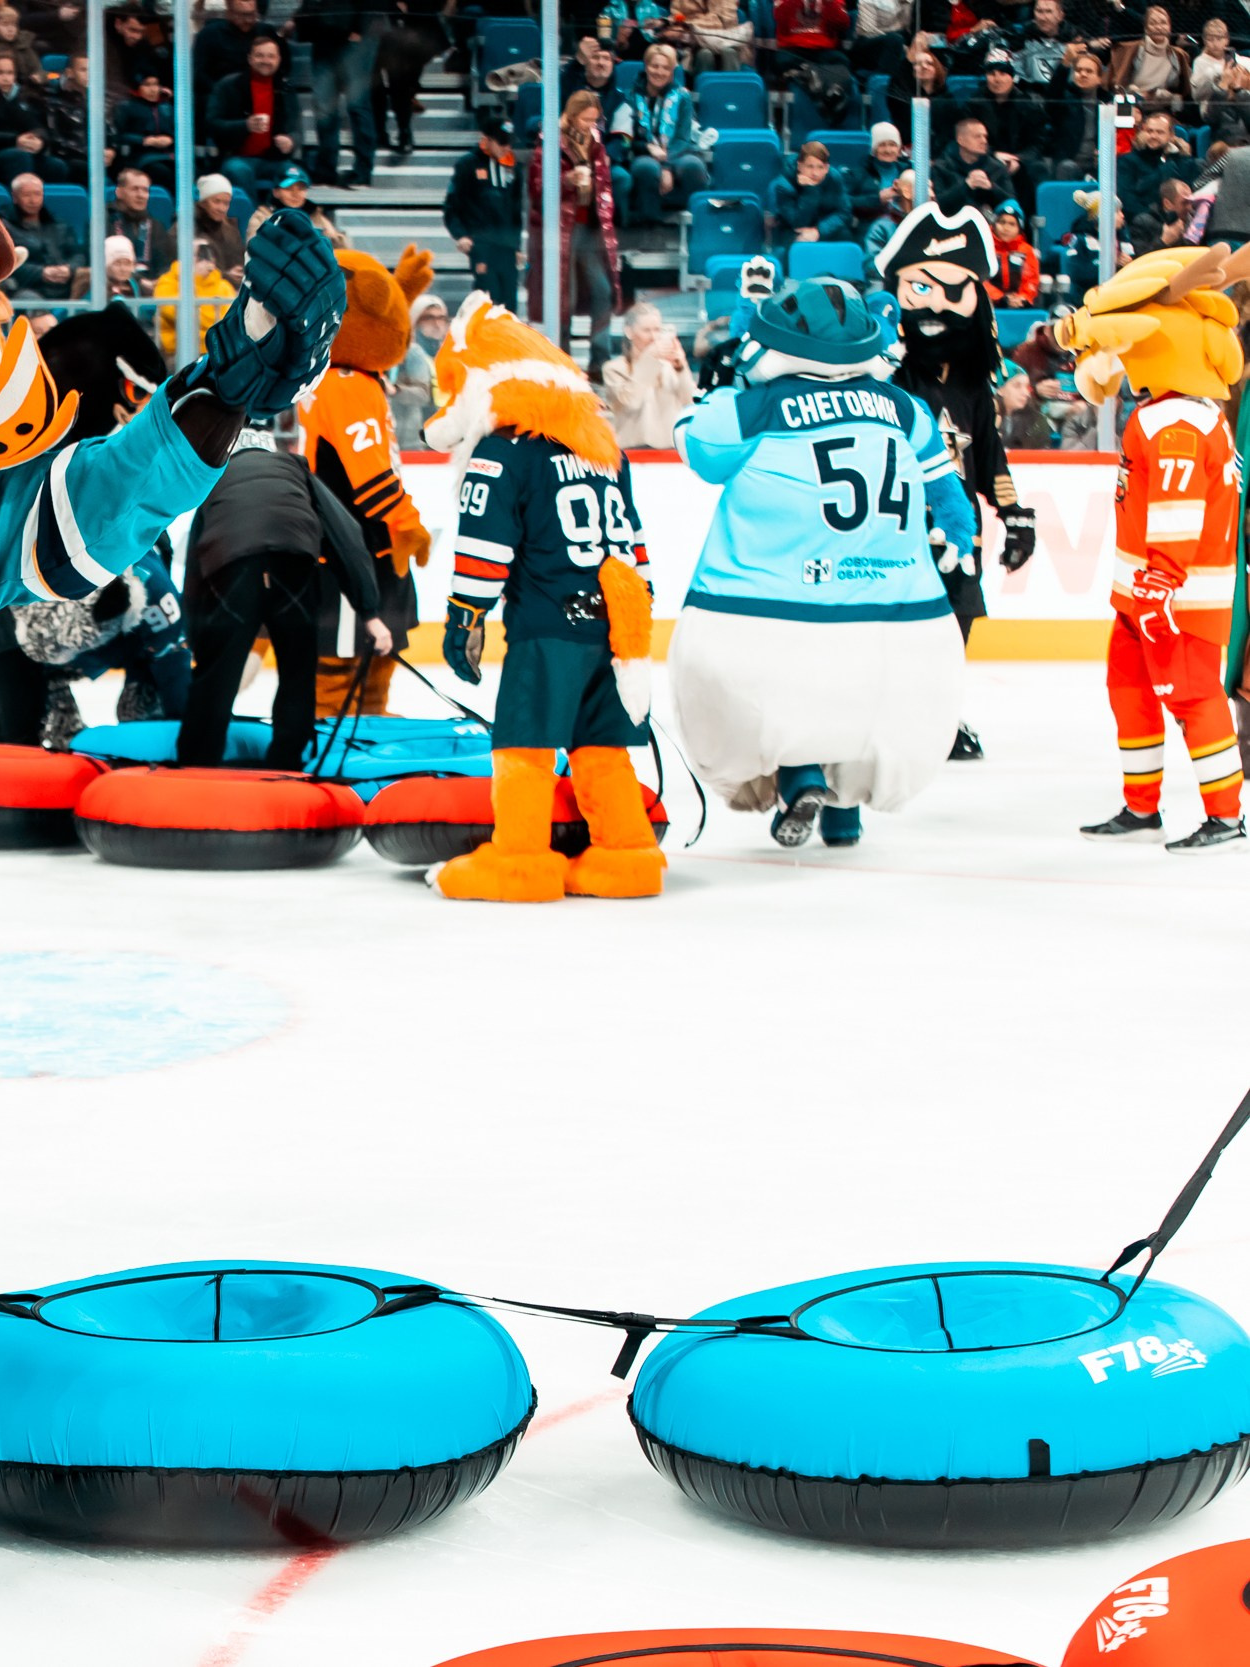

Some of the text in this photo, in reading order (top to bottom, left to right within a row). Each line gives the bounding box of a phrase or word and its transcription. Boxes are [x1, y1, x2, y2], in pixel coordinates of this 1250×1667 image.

[458, 481, 489, 516] 99
[811, 436, 910, 533] 54
[1159, 459, 1195, 492] 77
[556, 484, 637, 567] 99
[141, 592, 181, 632] 99
[1077, 1335, 1168, 1384] F78
[1112, 1576, 1170, 1622] F78
